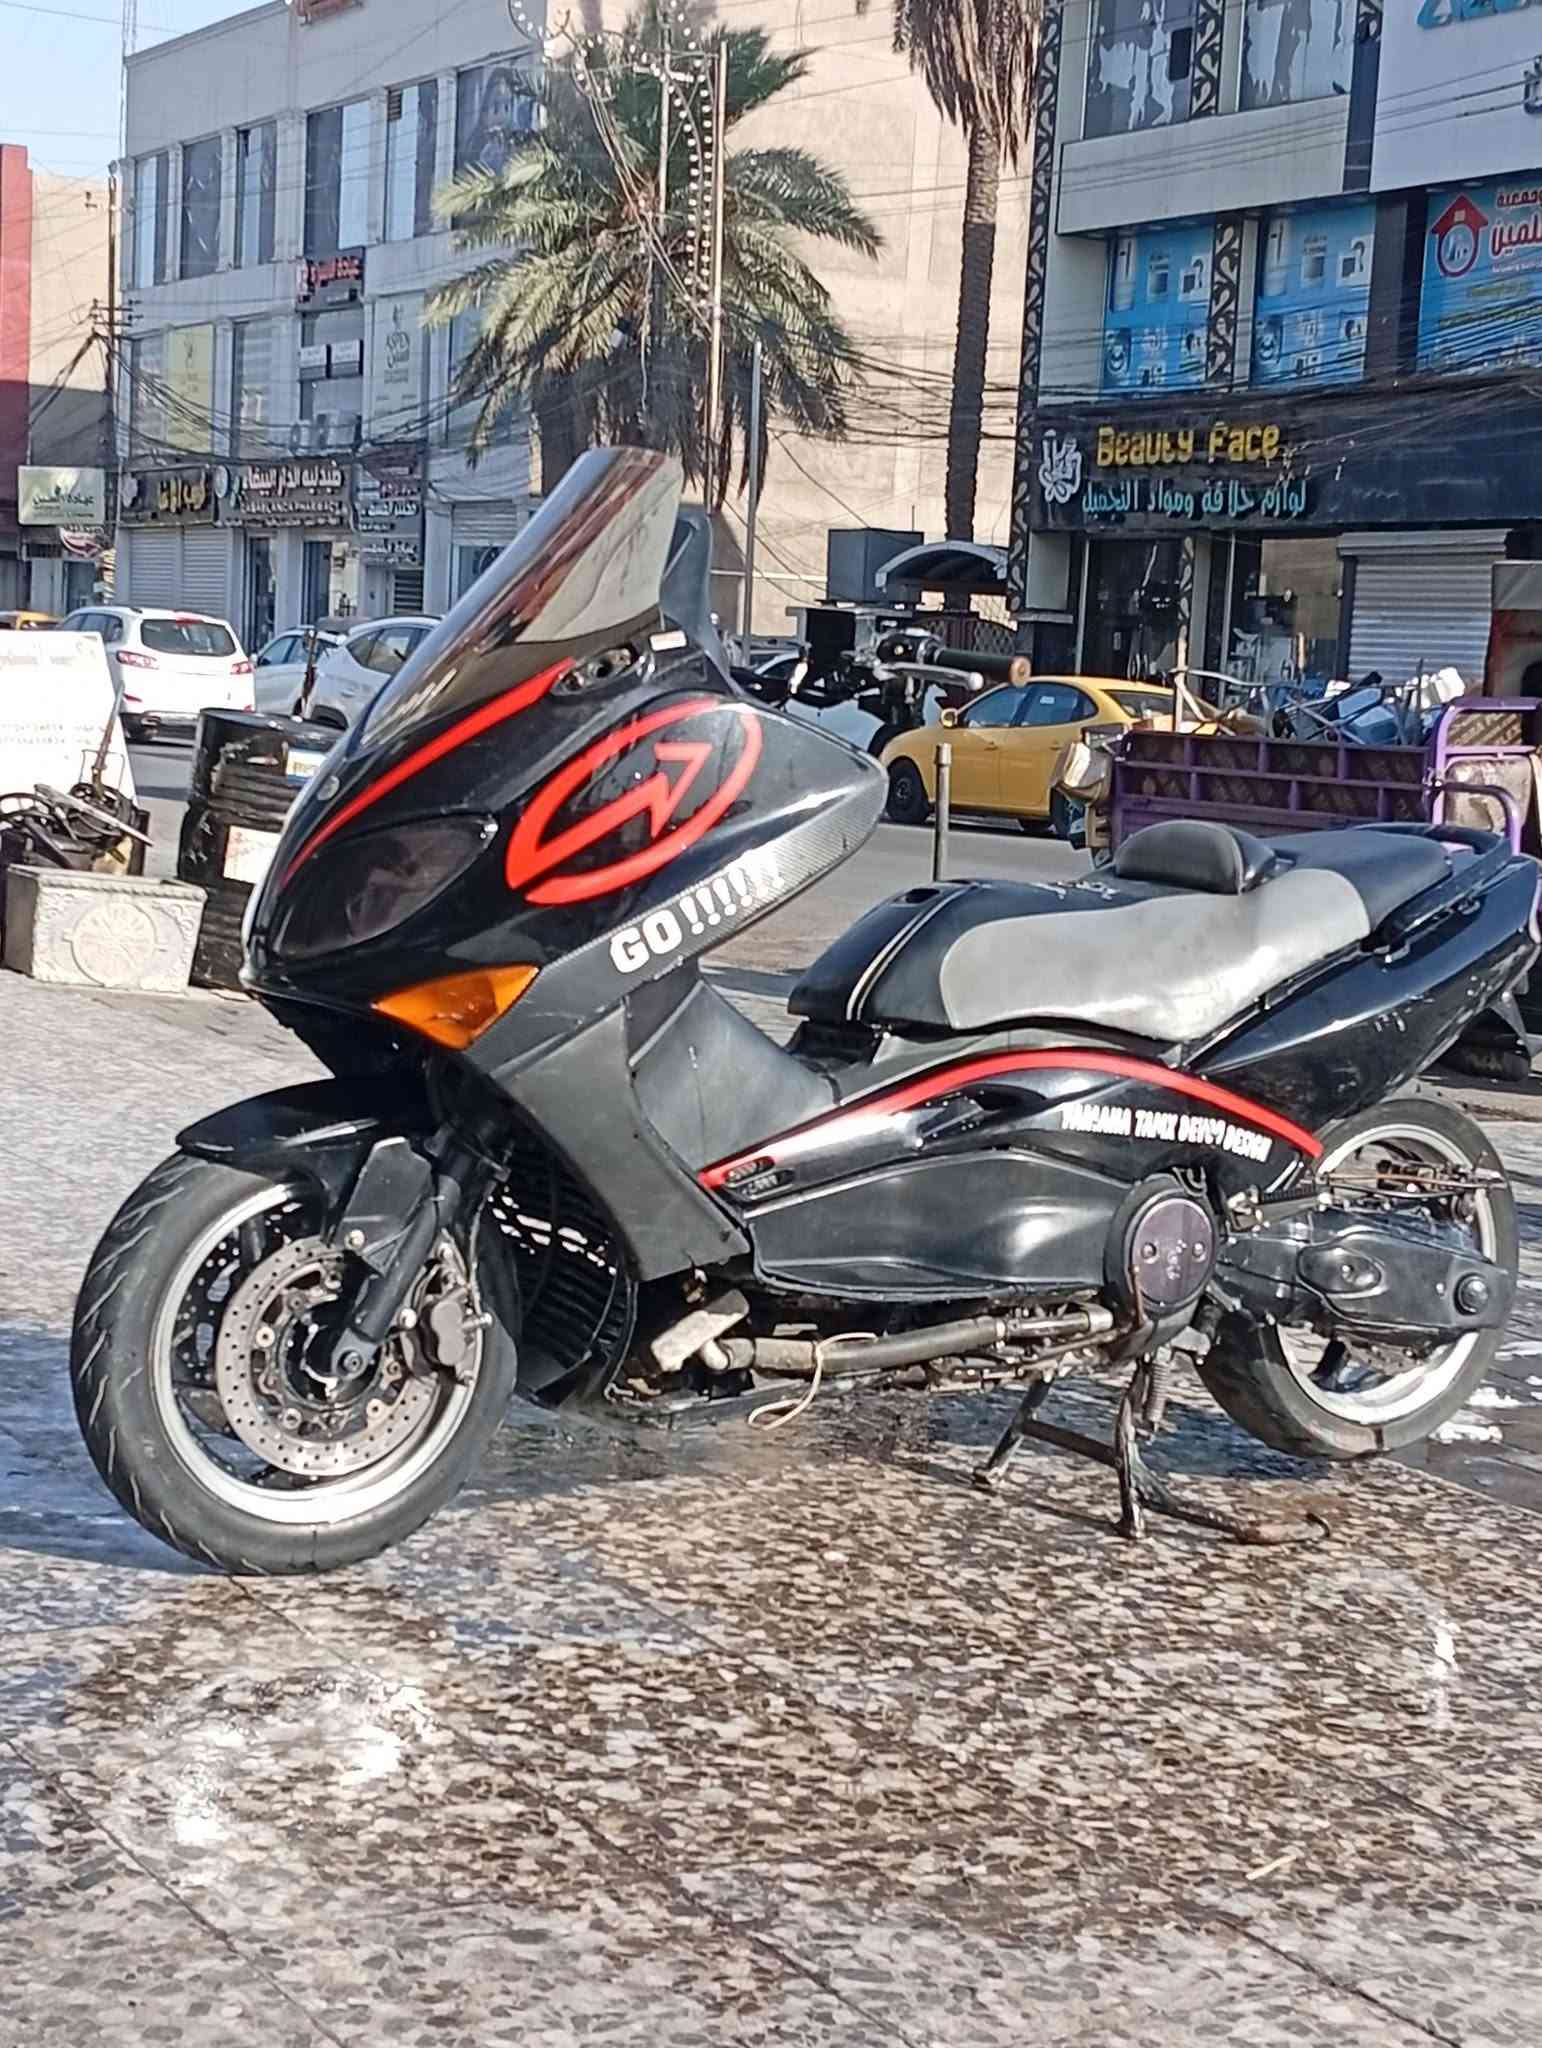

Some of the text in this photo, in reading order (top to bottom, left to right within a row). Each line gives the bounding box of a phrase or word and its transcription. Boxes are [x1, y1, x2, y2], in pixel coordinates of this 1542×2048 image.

[1097, 425, 1195, 467] Beauty
[1207, 421, 1281, 467] Face
[1261, 479, 1307, 518] لوازم
